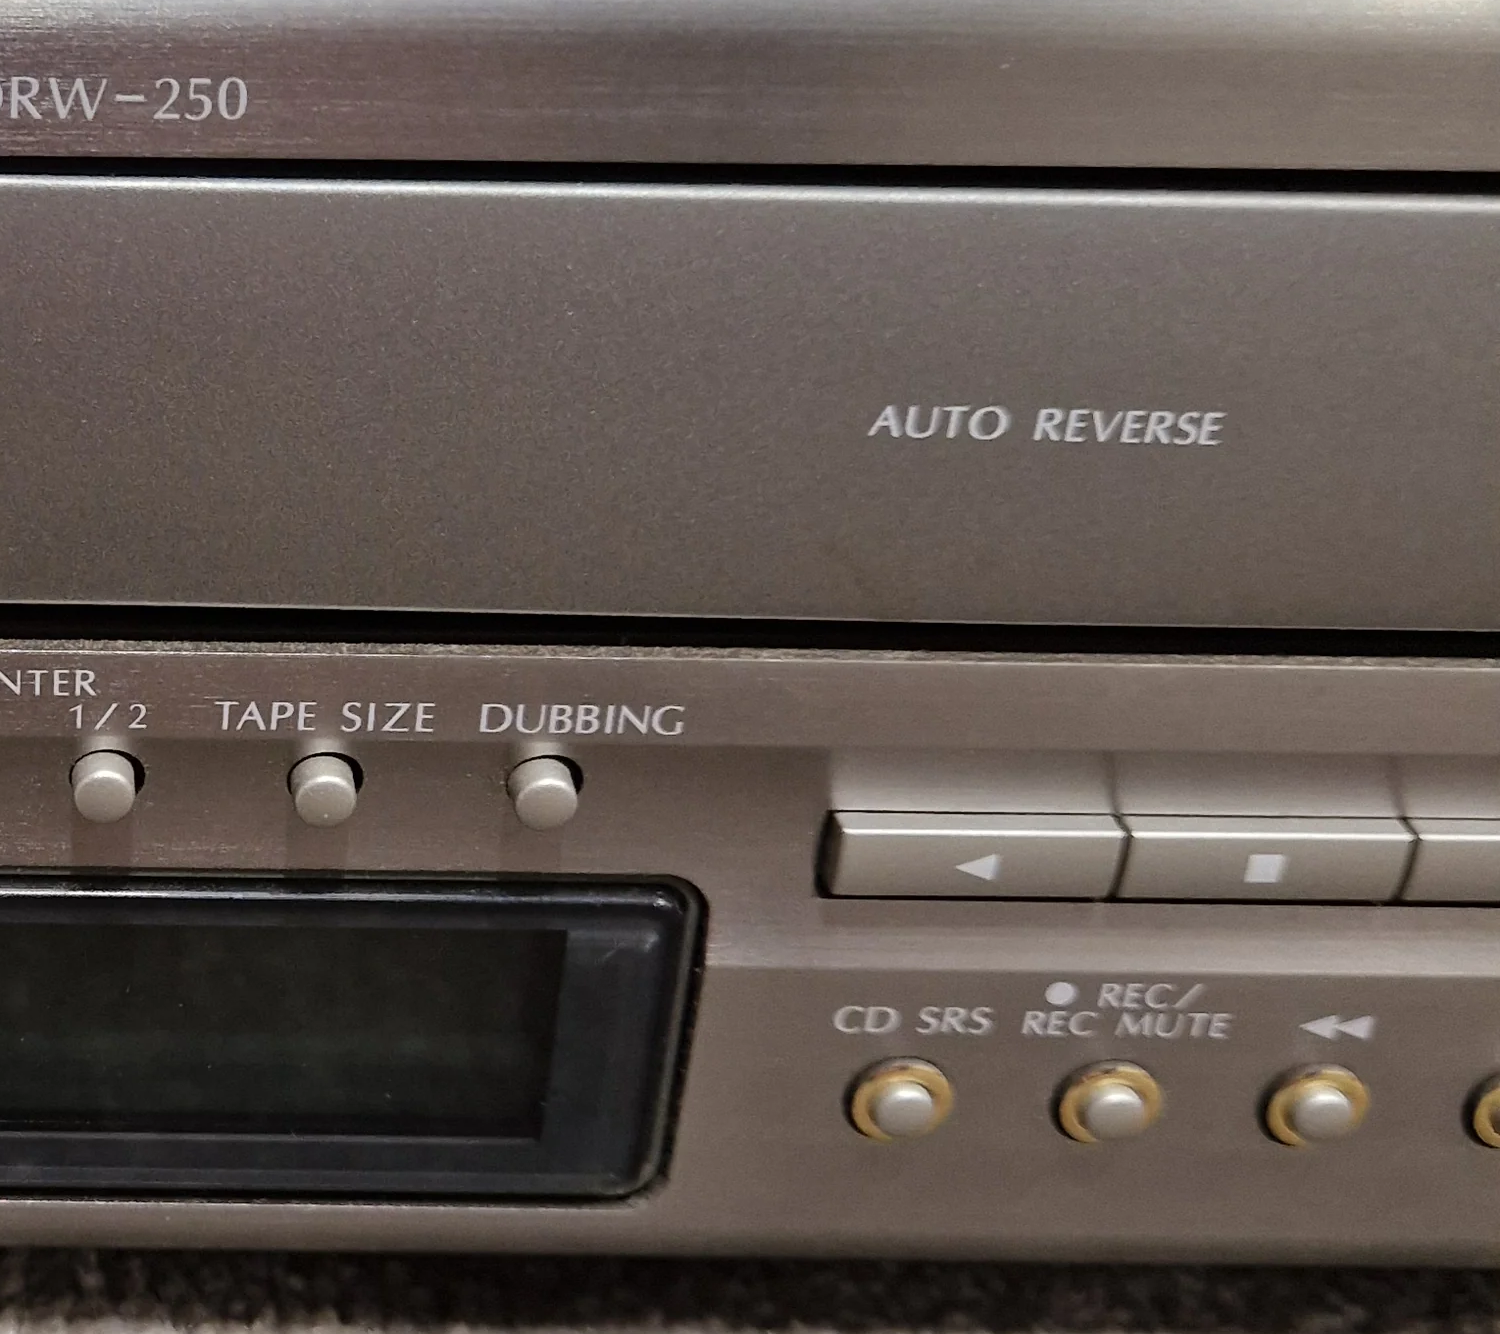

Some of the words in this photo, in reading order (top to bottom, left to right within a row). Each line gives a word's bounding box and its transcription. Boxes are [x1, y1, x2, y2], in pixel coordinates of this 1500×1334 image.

[867, 405, 1010, 441] AUTO
[1032, 409, 1226, 446] REVERSE
[67, 704, 148, 731] 1/2
[214, 701, 317, 731] TAPE
[340, 702, 436, 733] SIZE
[478, 705, 686, 736] DUBBING
[1098, 983, 1206, 1010] REC/
[831, 1006, 898, 1034] CD
[915, 1007, 994, 1036] SRS
[1021, 1011, 1098, 1038] REC
[1113, 1012, 1233, 1039] MUTE
